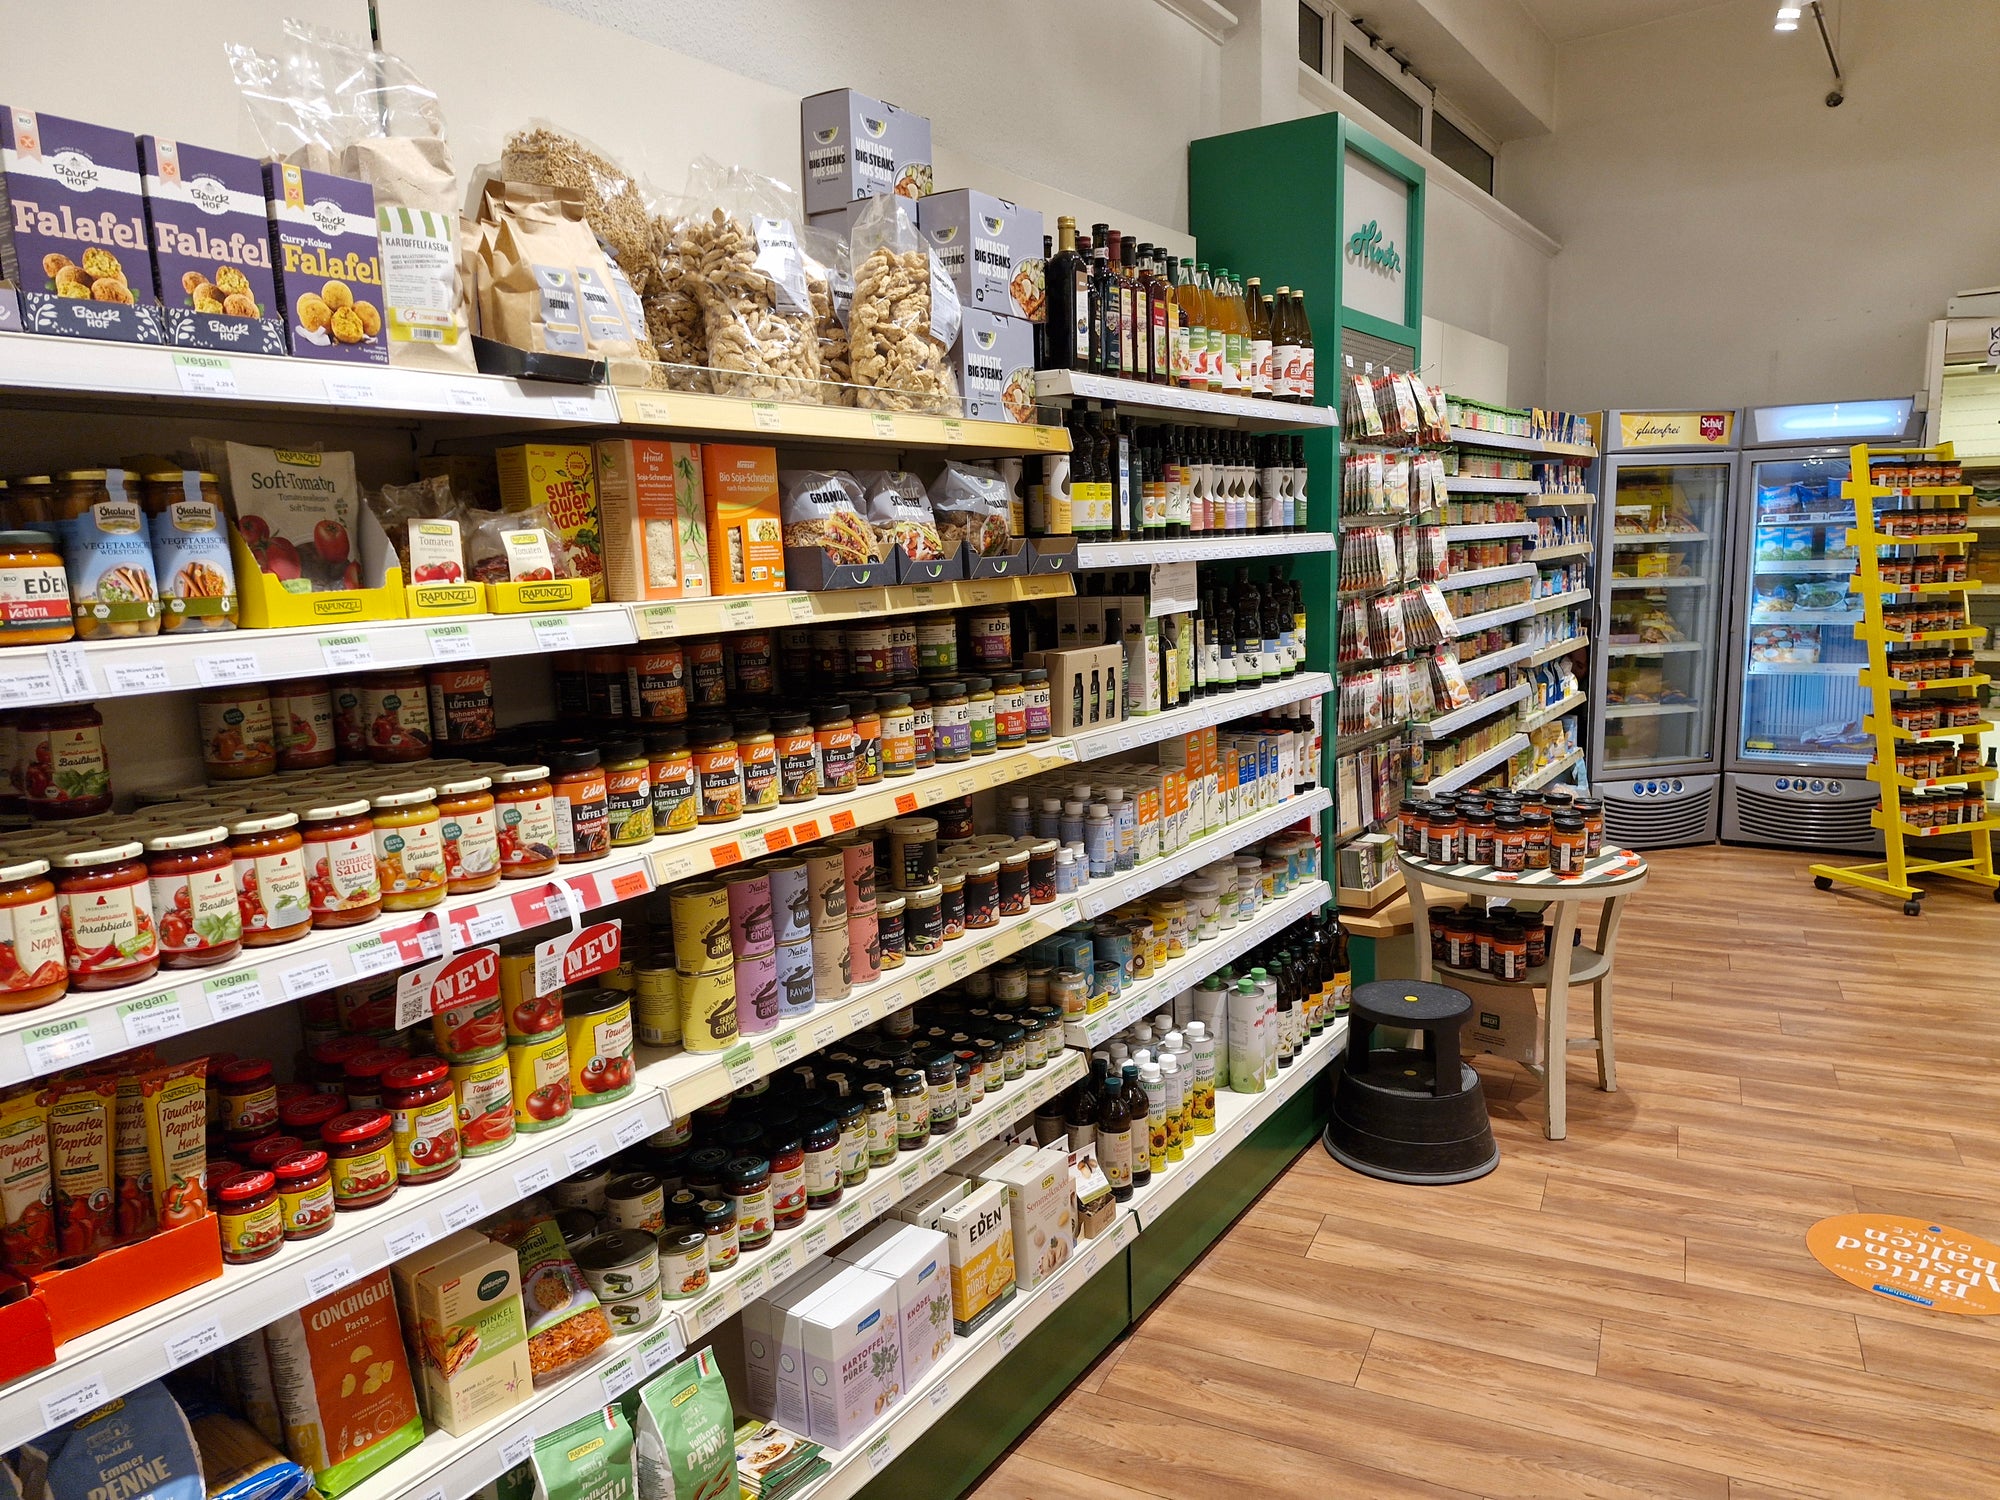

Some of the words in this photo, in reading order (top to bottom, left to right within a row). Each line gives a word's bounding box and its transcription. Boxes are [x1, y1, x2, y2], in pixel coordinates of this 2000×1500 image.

[809, 146, 844, 160] VANTASTIC
[856, 138, 893, 160] VANTASTIC
[809, 157, 820, 169] BIG
[821, 154, 845, 168] STEAKS
[855, 150, 869, 163] BIG
[871, 153, 894, 172] STEAKS
[52, 163, 98, 181] Bauck
[813, 166, 825, 177] AUS
[826, 165, 843, 175] SOJA
[860, 164, 873, 178] AUS
[875, 167, 892, 183] SOJA
[66, 175, 88, 187] HOF
[191, 188, 230, 205] Bauck
[202, 200, 221, 210] HOF
[11, 199, 148, 251] Falafel
[312, 211, 346, 227] Bauck
[322, 221, 338, 231] HOF
[154, 222, 272, 268] Falafel
[280, 233, 332, 250] Curry-Kokos
[385, 237, 449, 253] KARTOFFELFASERN
[975, 237, 1010, 255] VANTASTIC
[282, 243, 382, 285] Falafel
[974, 250, 986, 262] BIG
[987, 253, 1011, 268] STEAKS
[978, 261, 990, 276] AUS
[991, 265, 1009, 280] SOJA
[549, 299, 569, 310] SEITAN
[72, 305, 120, 323] Bauck
[86, 317, 109, 328] HOF
[208, 320, 249, 336] Bauck
[220, 331, 240, 342] HOF
[182, 355, 222, 368] vegan
[968, 353, 1002, 370] VANTASTIC
[968, 365, 979, 378] BIG
[980, 367, 1002, 381] STEAKS
[972, 378, 983, 390] AUS
[985, 379, 1000, 392] SOJA
[1701, 415, 1724, 430] Schär
[1636, 422, 1680, 440] glutenfrei
[719, 473, 730, 482] Bio
[731, 473, 775, 482] Soja-Schnetzel
[100, 506, 135, 516] Ökoland
[177, 506, 211, 515] Ökoland
[420, 525, 451, 534] RAPUNZEL
[419, 537, 454, 547] Tomaten
[514, 547, 542, 555] Tomaten
[24, 578, 67, 594] EDEN
[521, 587, 570, 600] RAPUNZEL
[420, 587, 473, 602] RAPUNZEL
[315, 601, 362, 614] RAPUNZEL
[537, 618, 562, 627] vegan
[433, 626, 462, 635] vegan
[327, 634, 361, 645] vegan
[646, 658, 674, 671] Eden
[454, 674, 484, 689] Eden
[642, 680, 665, 689] LÖFFEL
[666, 679, 682, 687] ZEIT
[789, 740, 812, 752] Eden
[830, 734, 852, 745] Eden
[753, 747, 775, 760] Eden
[826, 753, 847, 762] LÖFFEL
[58, 756, 102, 767] Basilikum
[710, 756, 735, 769] Eden
[785, 760, 806, 769] LÖFFEL
[659, 766, 686, 779] Eden
[748, 769, 769, 778] LÖFFEL
[609, 776, 639, 790] Eden
[655, 789, 679, 798] LÖFFEL
[680, 786, 691, 795] ZEIT
[632, 798, 644, 807] ZEIT
[655, 797, 681, 806] Gemüse-
[577, 809, 600, 821] LÖFFEL
[407, 850, 439, 861] Kurkuma
[336, 862, 372, 876] sauce
[271, 880, 300, 893] Ricotta
[200, 896, 238, 912] Basilikum
[79, 912, 128, 923] Tomatensauce
[77, 920, 132, 935] Arrabbiata
[565, 930, 618, 975] NEU
[212, 972, 250, 988] vegan
[435, 953, 495, 1005] NEU
[790, 985, 812, 997] RAVIOLI
[127, 994, 169, 1012] vegan
[161, 1015, 176, 1023] 2,99
[32, 1020, 78, 1038] vegan
[732, 1056, 751, 1068] vegan
[162, 1085, 199, 1101] RAPUNZEL
[472, 1079, 504, 1094] Tomaten
[54, 1102, 98, 1115] RAPUNZEL
[162, 1100, 206, 1122] Tomaten
[51, 1119, 104, 1135] Tomaten
[166, 1116, 207, 1137] Paprika
[55, 1132, 103, 1151] Paprika
[177, 1136, 202, 1150] Mark
[11, 1151, 44, 1172] Mark
[65, 1152, 94, 1166] Mark
[1042, 1175, 1055, 1189] EDEN
[742, 1203, 765, 1213] Tomaten
[970, 1207, 1001, 1242] EDEN
[1864, 1228, 1999, 1276] halten
[967, 1271, 987, 1298] PÜREE
[1865, 1258, 1970, 1299] Bitte
[1879, 1285, 1932, 1305] Reformhaus
[311, 1278, 391, 1331] CONCHIGLIE
[907, 1294, 931, 1321] KNÖDEL
[344, 1315, 370, 1333] Pasta
[480, 1307, 513, 1329] DINKEL
[481, 1313, 515, 1336] LASAGNE
[642, 1331, 665, 1348] vegan
[842, 1336, 884, 1374] KARTOFFEL
[603, 1359, 628, 1377] vegan
[843, 1360, 868, 1385] PÜREE
[689, 1424, 720, 1448] Vollkorn
[686, 1429, 728, 1471] PENNE
[100, 1452, 145, 1482] Emmer
[702, 1456, 720, 1472] Pasta
[88, 1456, 172, 1500] PENNE
